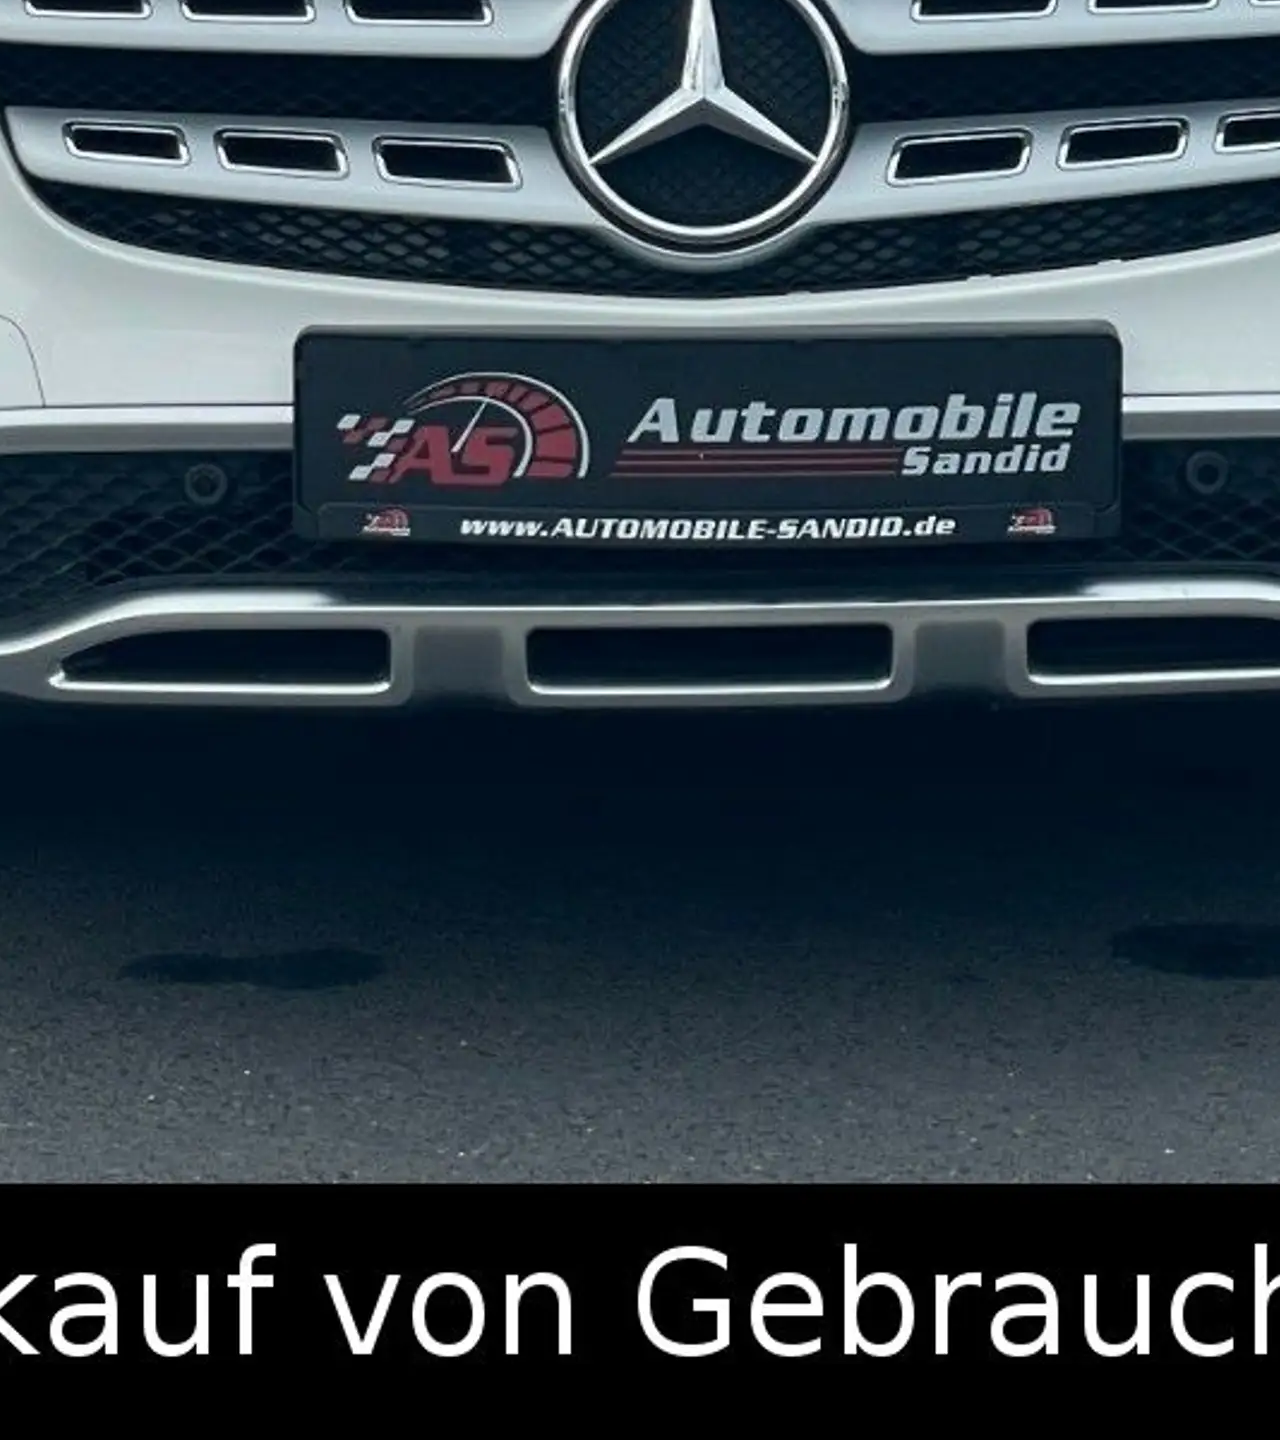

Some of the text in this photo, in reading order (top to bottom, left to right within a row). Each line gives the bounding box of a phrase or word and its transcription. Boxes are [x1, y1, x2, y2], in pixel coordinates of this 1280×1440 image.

[627, 392, 1081, 443] Automobile
[388, 425, 519, 487] AS
[901, 443, 1071, 476] Sandid
[460, 515, 956, 540] www.AUTOMOBILE-SANDID.de
